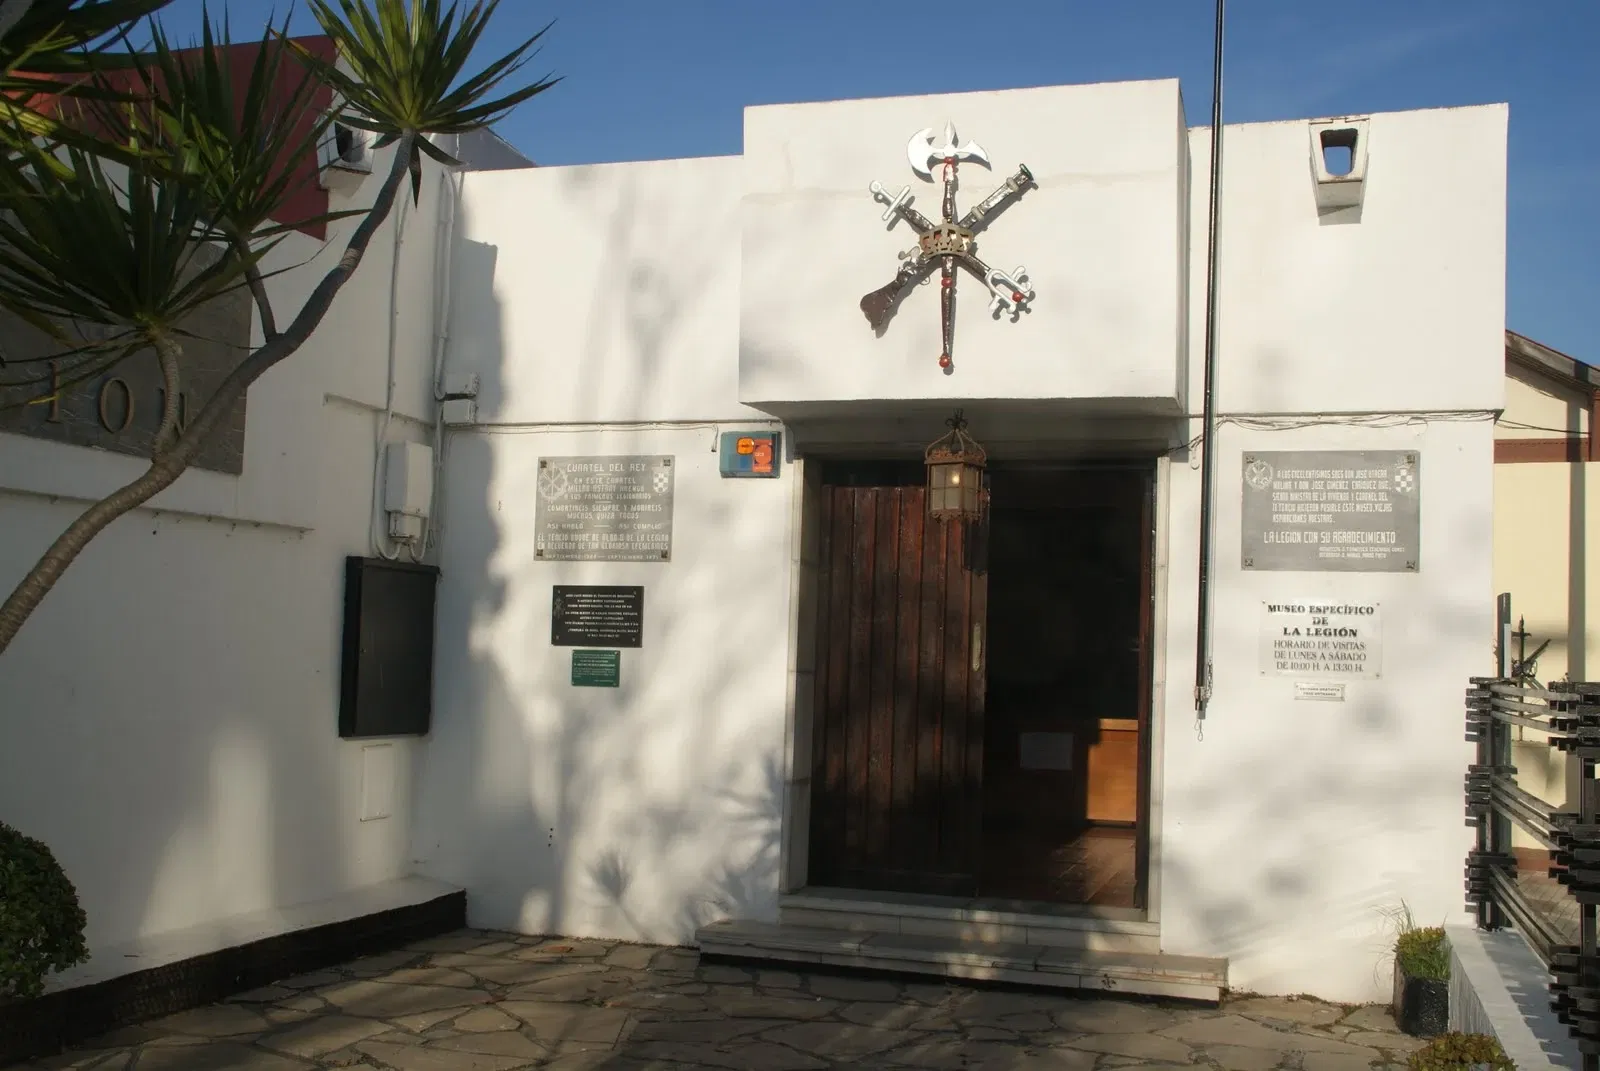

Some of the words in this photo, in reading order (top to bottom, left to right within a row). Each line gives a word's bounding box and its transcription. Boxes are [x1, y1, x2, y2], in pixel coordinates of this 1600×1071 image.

[567, 463, 604, 472] CUARTEL
[609, 463, 625, 472] DEL
[630, 463, 646, 472] REY
[1264, 532, 1275, 544] LA
[1276, 532, 1302, 544] LEGION
[1304, 532, 1318, 544] CON
[1321, 532, 1330, 544] SU
[1333, 532, 1396, 544] AGRADECIMIENTO
[1267, 605, 1306, 613] MUSEO
[1309, 604, 1374, 615] ESPECÍFICO
[1312, 616, 1329, 626] DE
[1283, 627, 1301, 636] LA
[1306, 627, 1358, 637] LEGIÓN
[1274, 640, 1316, 649] HORARIO
[1318, 641, 1330, 649] DE
[1274, 651, 1286, 659] DE
[1288, 651, 1317, 660] LUNES
[1320, 652, 1326, 660] A
[1328, 651, 1367, 661] SÁBADO
[1276, 662, 1288, 670] DE
[1291, 662, 1310, 670] 10:00
[1324, 663, 1330, 671] A
[1333, 663, 1353, 672] 13:30
